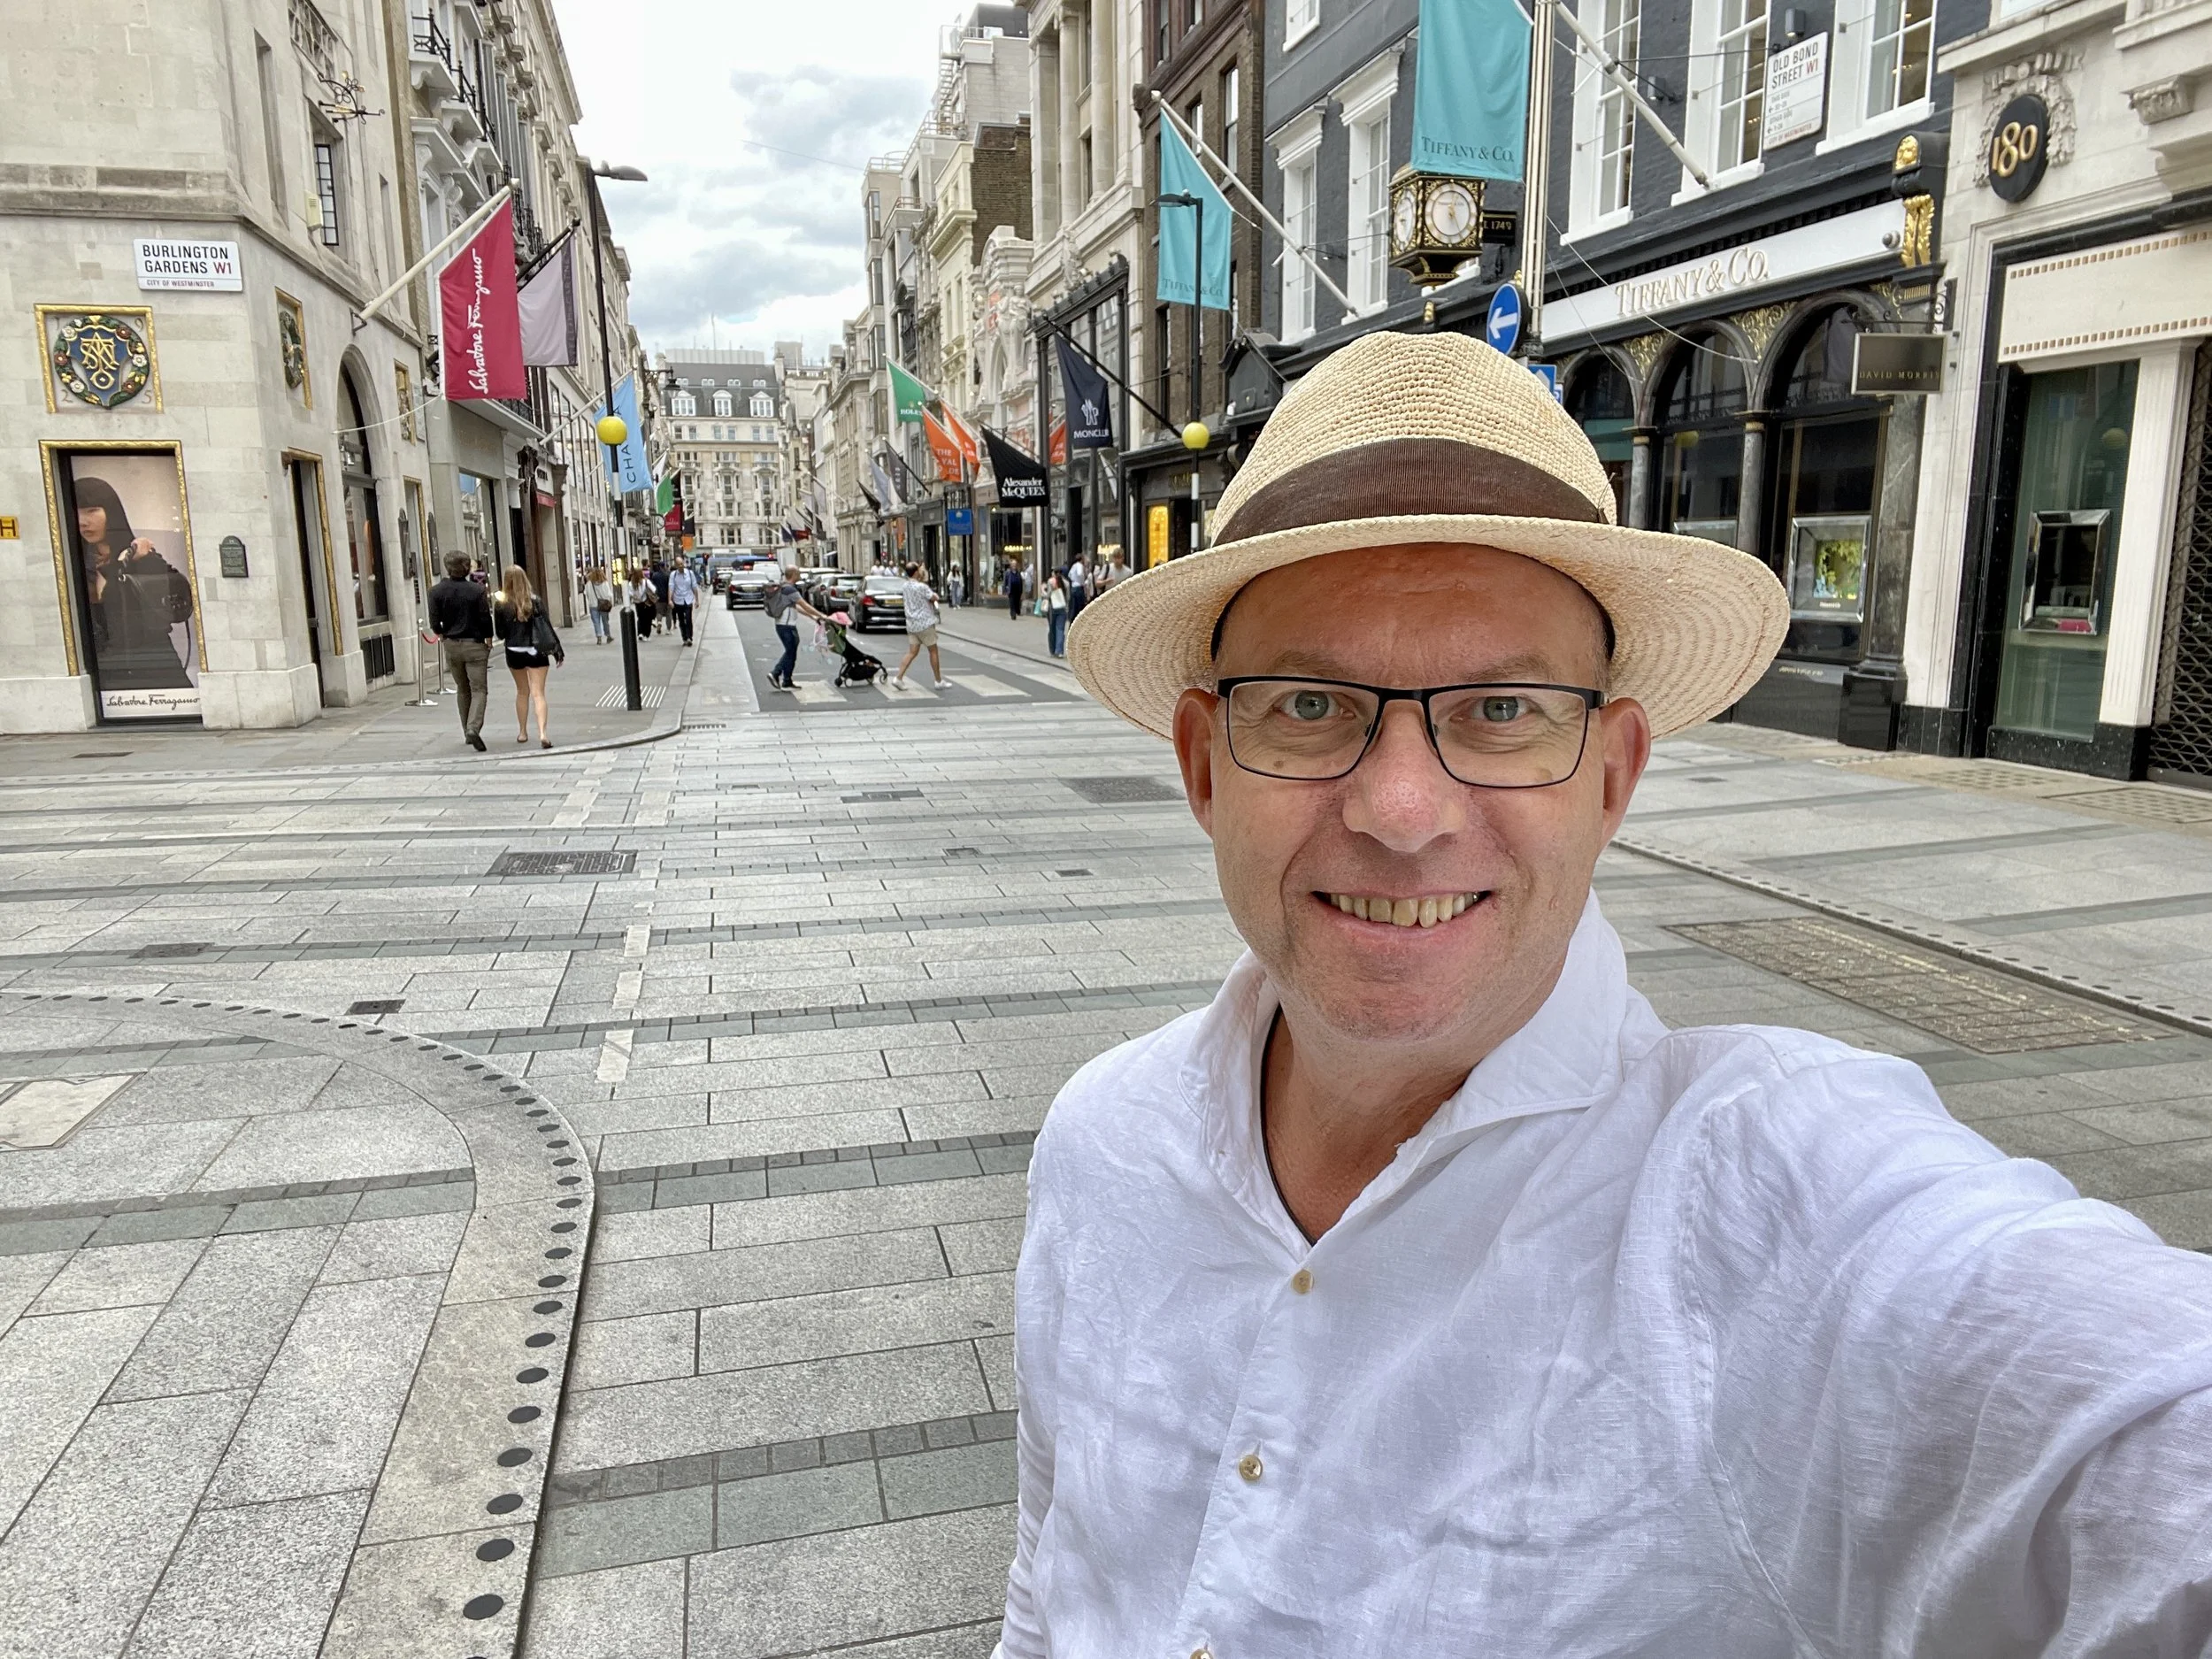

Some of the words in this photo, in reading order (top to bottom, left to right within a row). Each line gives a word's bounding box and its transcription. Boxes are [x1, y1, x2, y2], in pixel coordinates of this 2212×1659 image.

[1772, 54, 1790, 73] OLD
[1793, 42, 1818, 64] BOND
[1771, 65, 1804, 88] STREET
[1806, 58, 1818, 73] W1
[1421, 136, 1478, 158] TIFFANY
[1478, 145, 1489, 160] &
[1992, 121, 2038, 177] 180
[1491, 220, 1512, 231] 1749
[142, 244, 228, 259] BURLINGTON
[144, 260, 208, 273] GARDENS
[213, 262, 232, 274] W1
[467, 248, 491, 329] Ferragamo
[1615, 266, 1706, 316] TIFFANY
[1706, 259, 1725, 293] &
[134, 318, 144, 332] 9
[466, 330, 488, 394] Salvatore
[61, 388, 73, 403] 2
[142, 390, 152, 404] 5
[1002, 476, 1043, 488] Alexander
[1001, 487, 1046, 499] McQUEEN
[106, 695, 148, 707] Salvatore
[149, 694, 201, 710] Ferragamo
